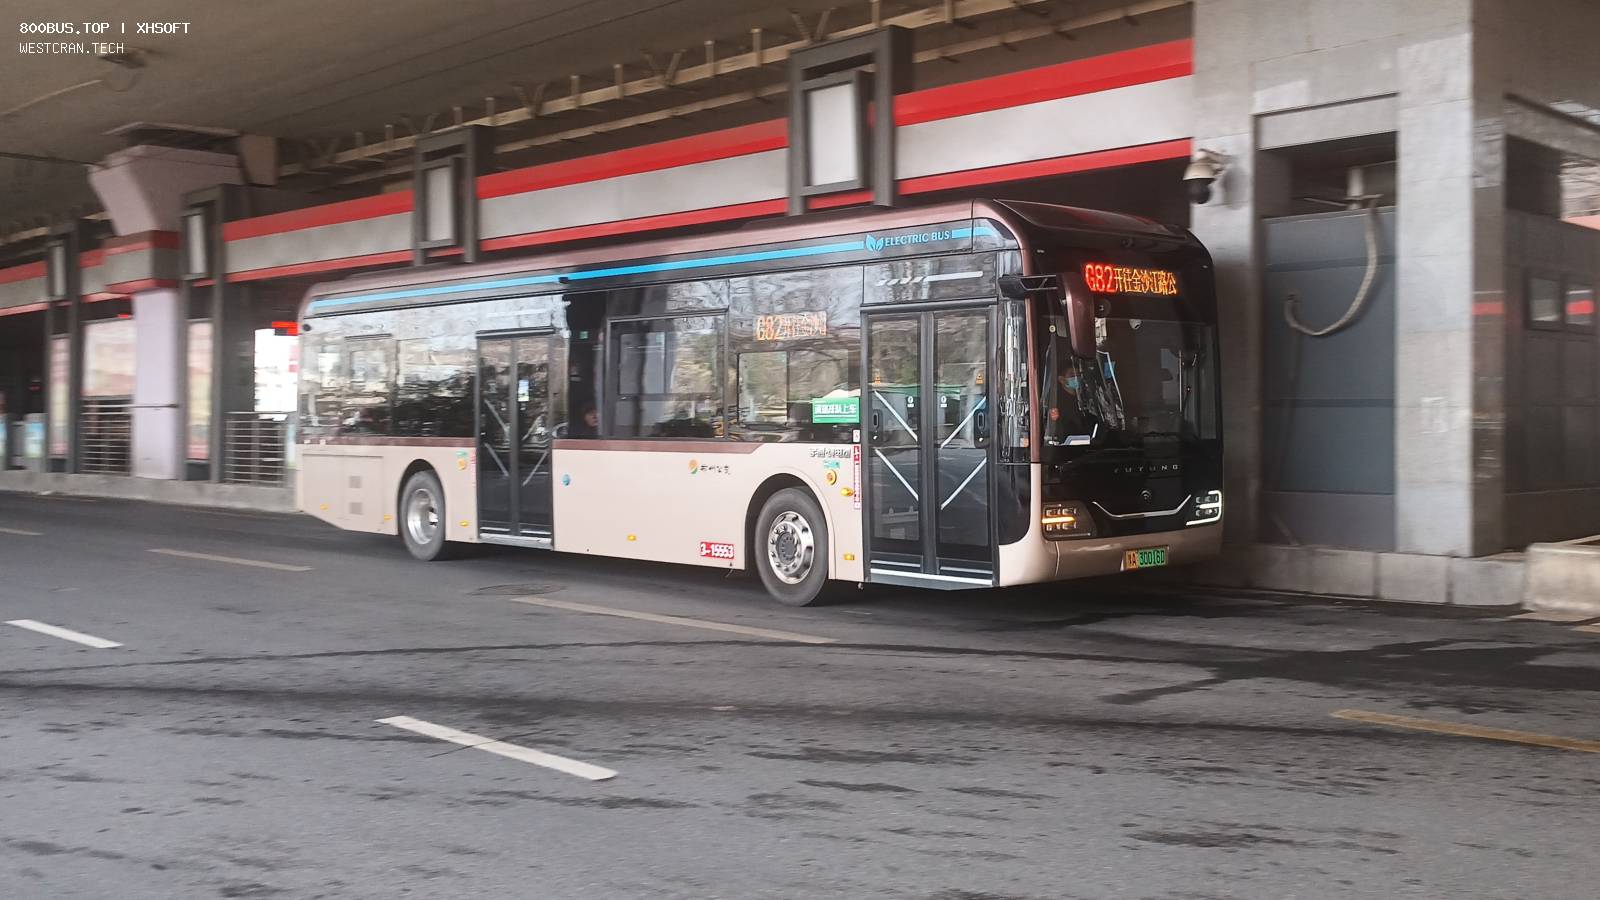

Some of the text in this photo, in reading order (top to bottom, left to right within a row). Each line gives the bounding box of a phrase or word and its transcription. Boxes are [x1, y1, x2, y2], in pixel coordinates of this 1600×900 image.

[885, 230, 951, 247] ELECTRIC BUS
[700, 543, 734, 558] 3-15553
